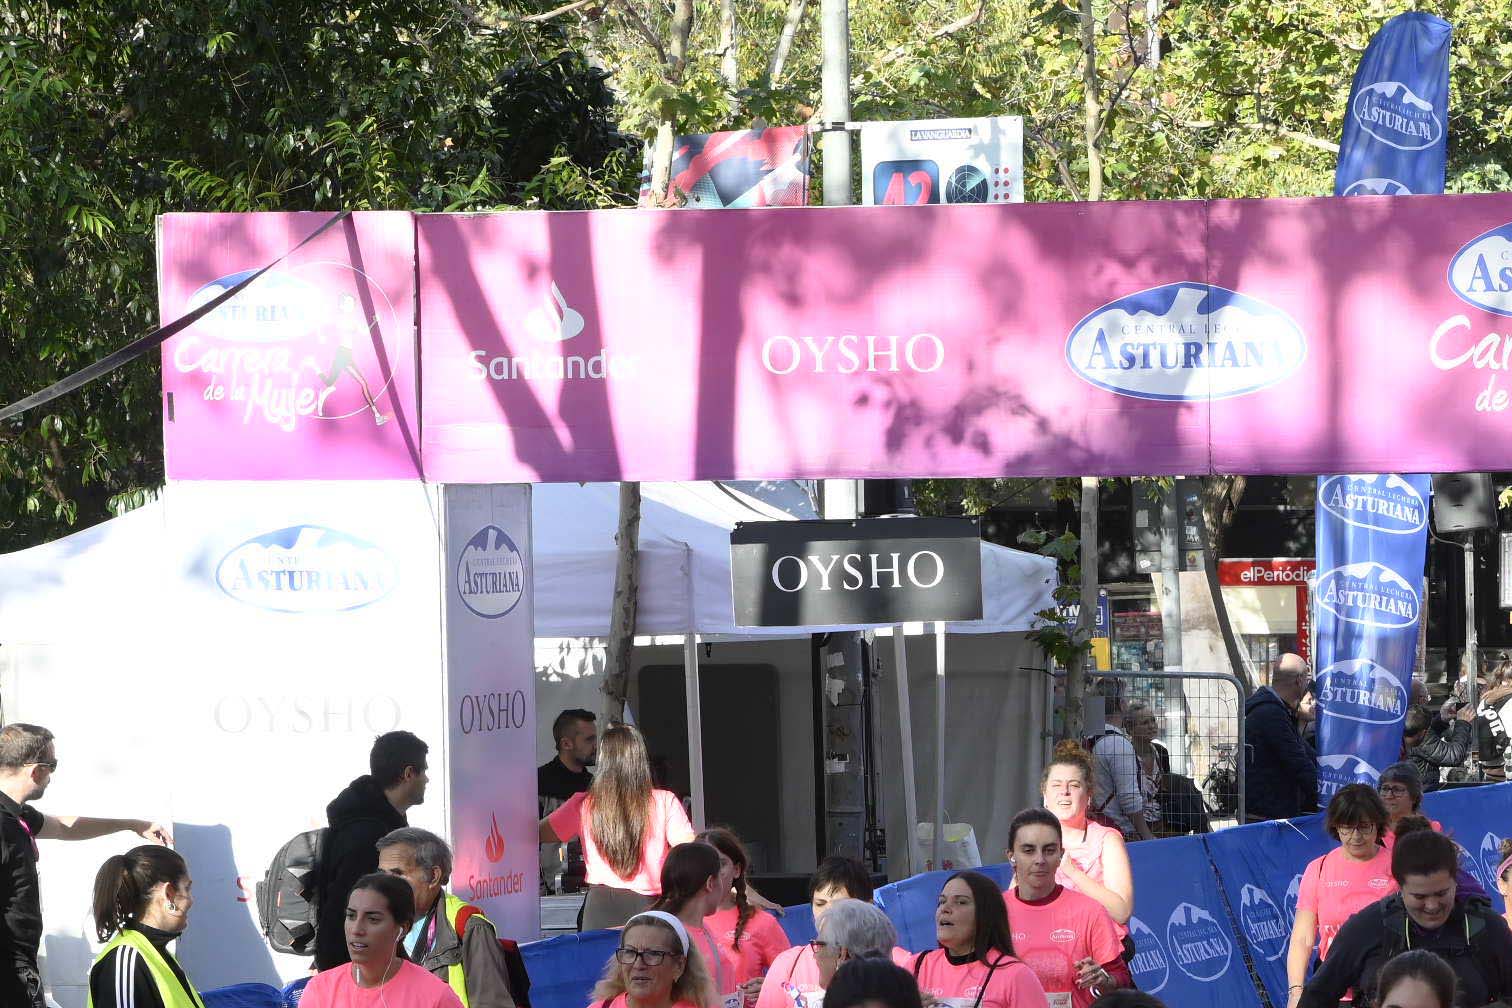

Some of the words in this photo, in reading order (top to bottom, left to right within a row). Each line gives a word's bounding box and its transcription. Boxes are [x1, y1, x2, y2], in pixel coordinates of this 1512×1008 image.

[761, 334, 946, 376] OYSHO
[203, 374, 225, 402] de
[1475, 374, 1511, 413] de
[1328, 483, 1420, 525] ASTURIANA
[462, 560, 521, 596] ASTURIANA
[772, 549, 946, 593] OYSHO
[1323, 578, 1413, 616] ASTURIANA
[214, 695, 401, 734] OYSHO
[460, 690, 527, 734] OYSHO
[469, 871, 525, 902] Santander
